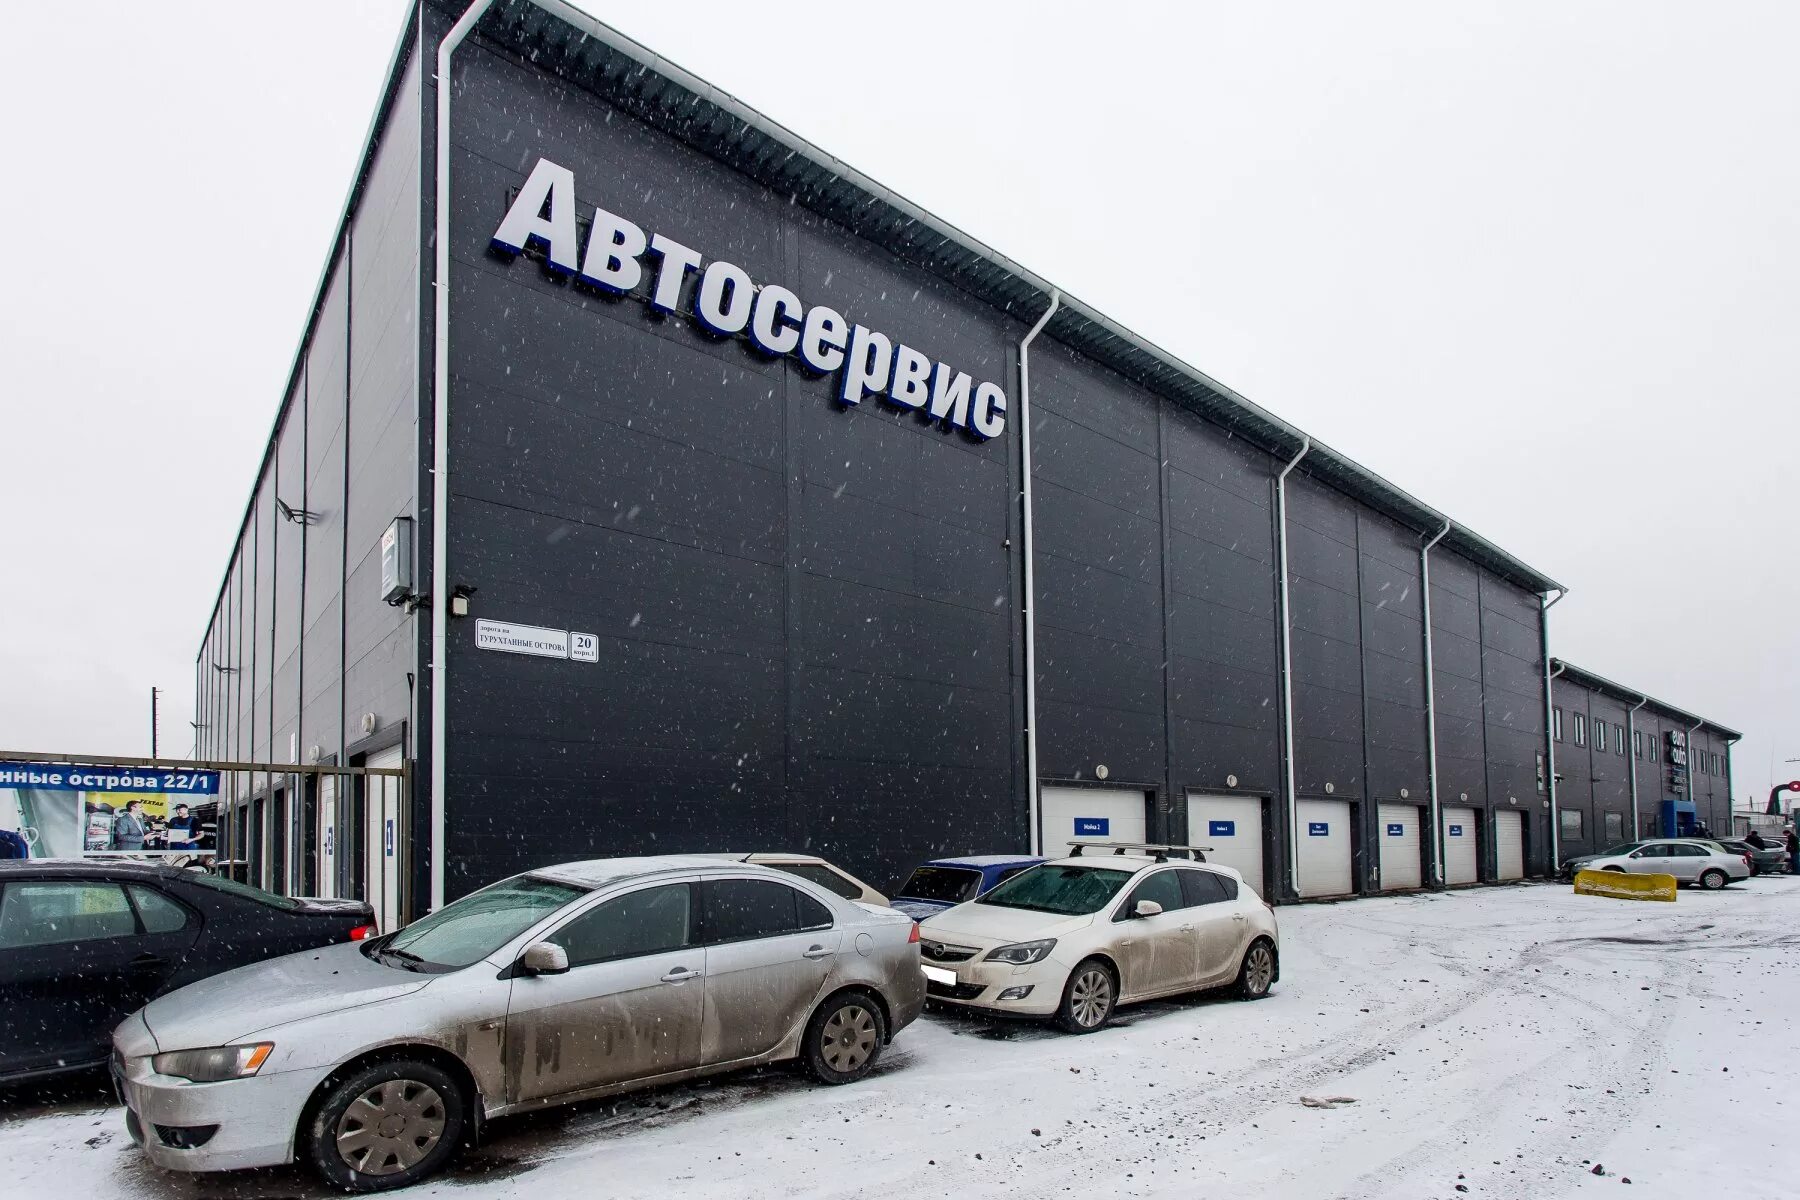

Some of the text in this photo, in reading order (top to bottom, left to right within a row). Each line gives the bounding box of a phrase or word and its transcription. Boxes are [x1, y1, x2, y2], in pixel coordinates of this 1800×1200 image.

[493, 157, 1007, 440] Автосервис
[480, 626, 501, 634] дорога
[480, 634, 566, 652] ТУРУХТАННЫЕ ОСТРОВА
[577, 637, 592, 649] 20
[0, 771, 209, 790] нные острова 22/1
